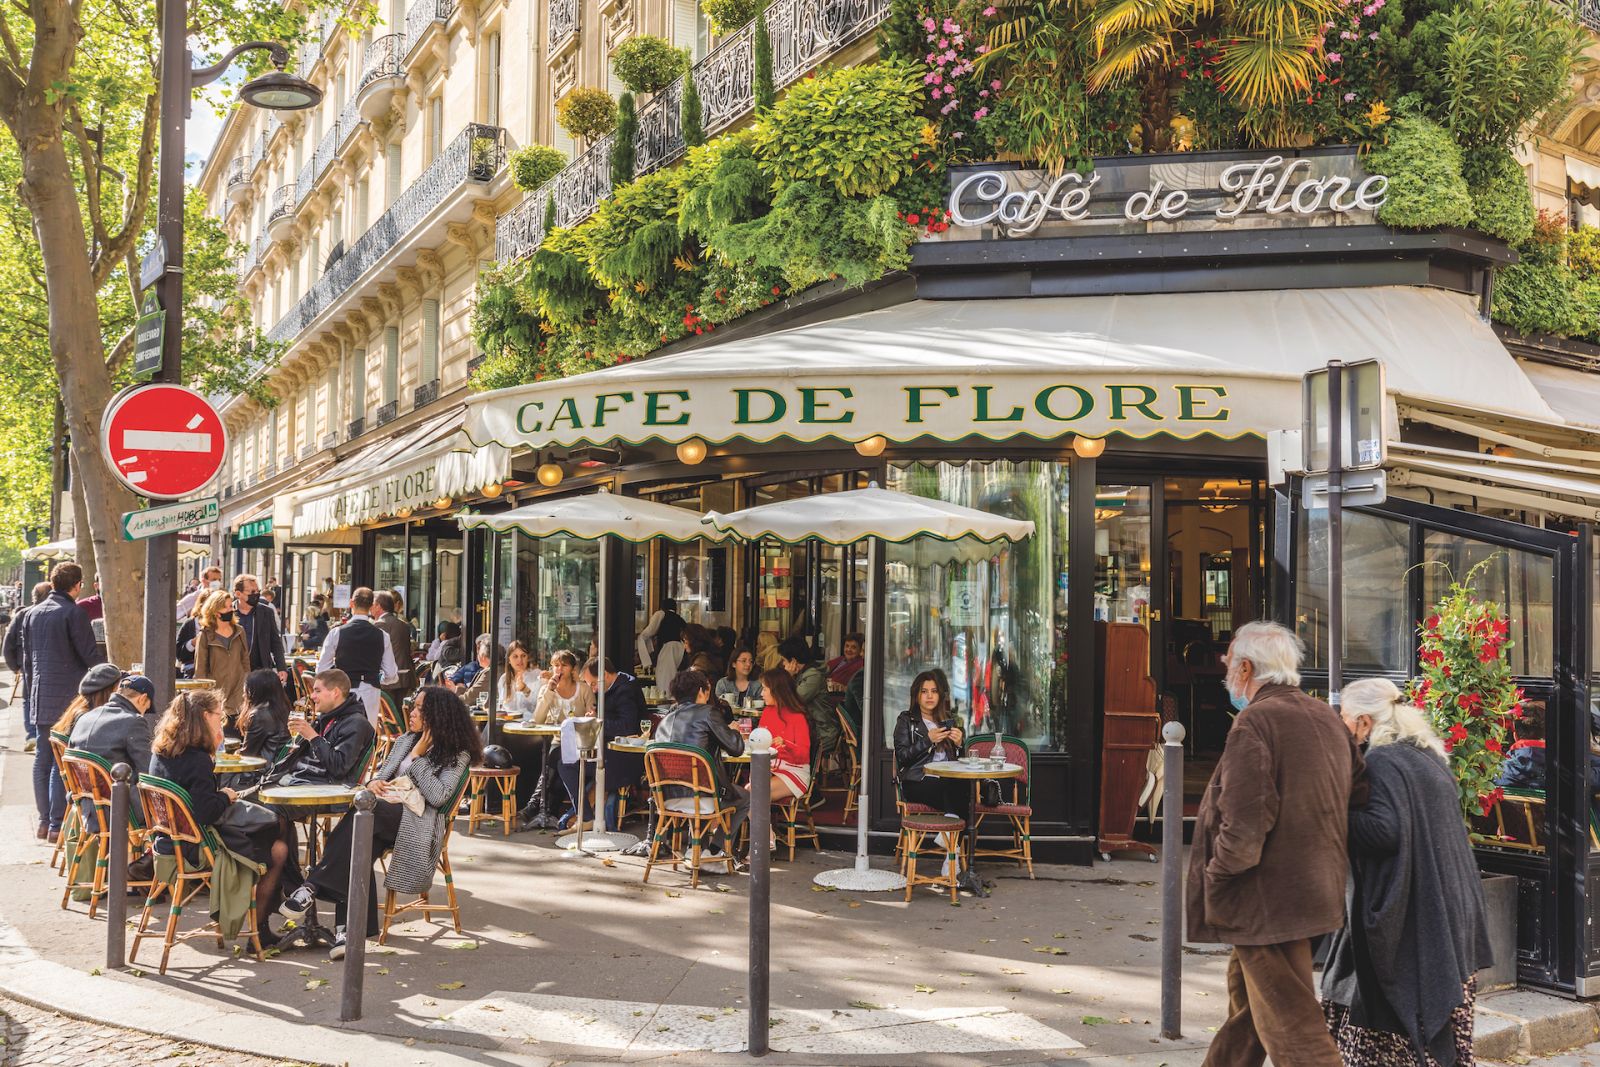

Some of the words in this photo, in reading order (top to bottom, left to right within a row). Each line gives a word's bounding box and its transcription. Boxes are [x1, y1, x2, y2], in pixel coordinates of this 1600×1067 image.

[950, 170, 1101, 239] Café
[1124, 180, 1190, 220] de
[1216, 155, 1390, 218] Flore
[514, 389, 693, 436] CAFE
[730, 386, 855, 425] DE
[901, 384, 1230, 424] FLORE
[361, 485, 380, 511] DE
[385, 465, 436, 505] FLORE
